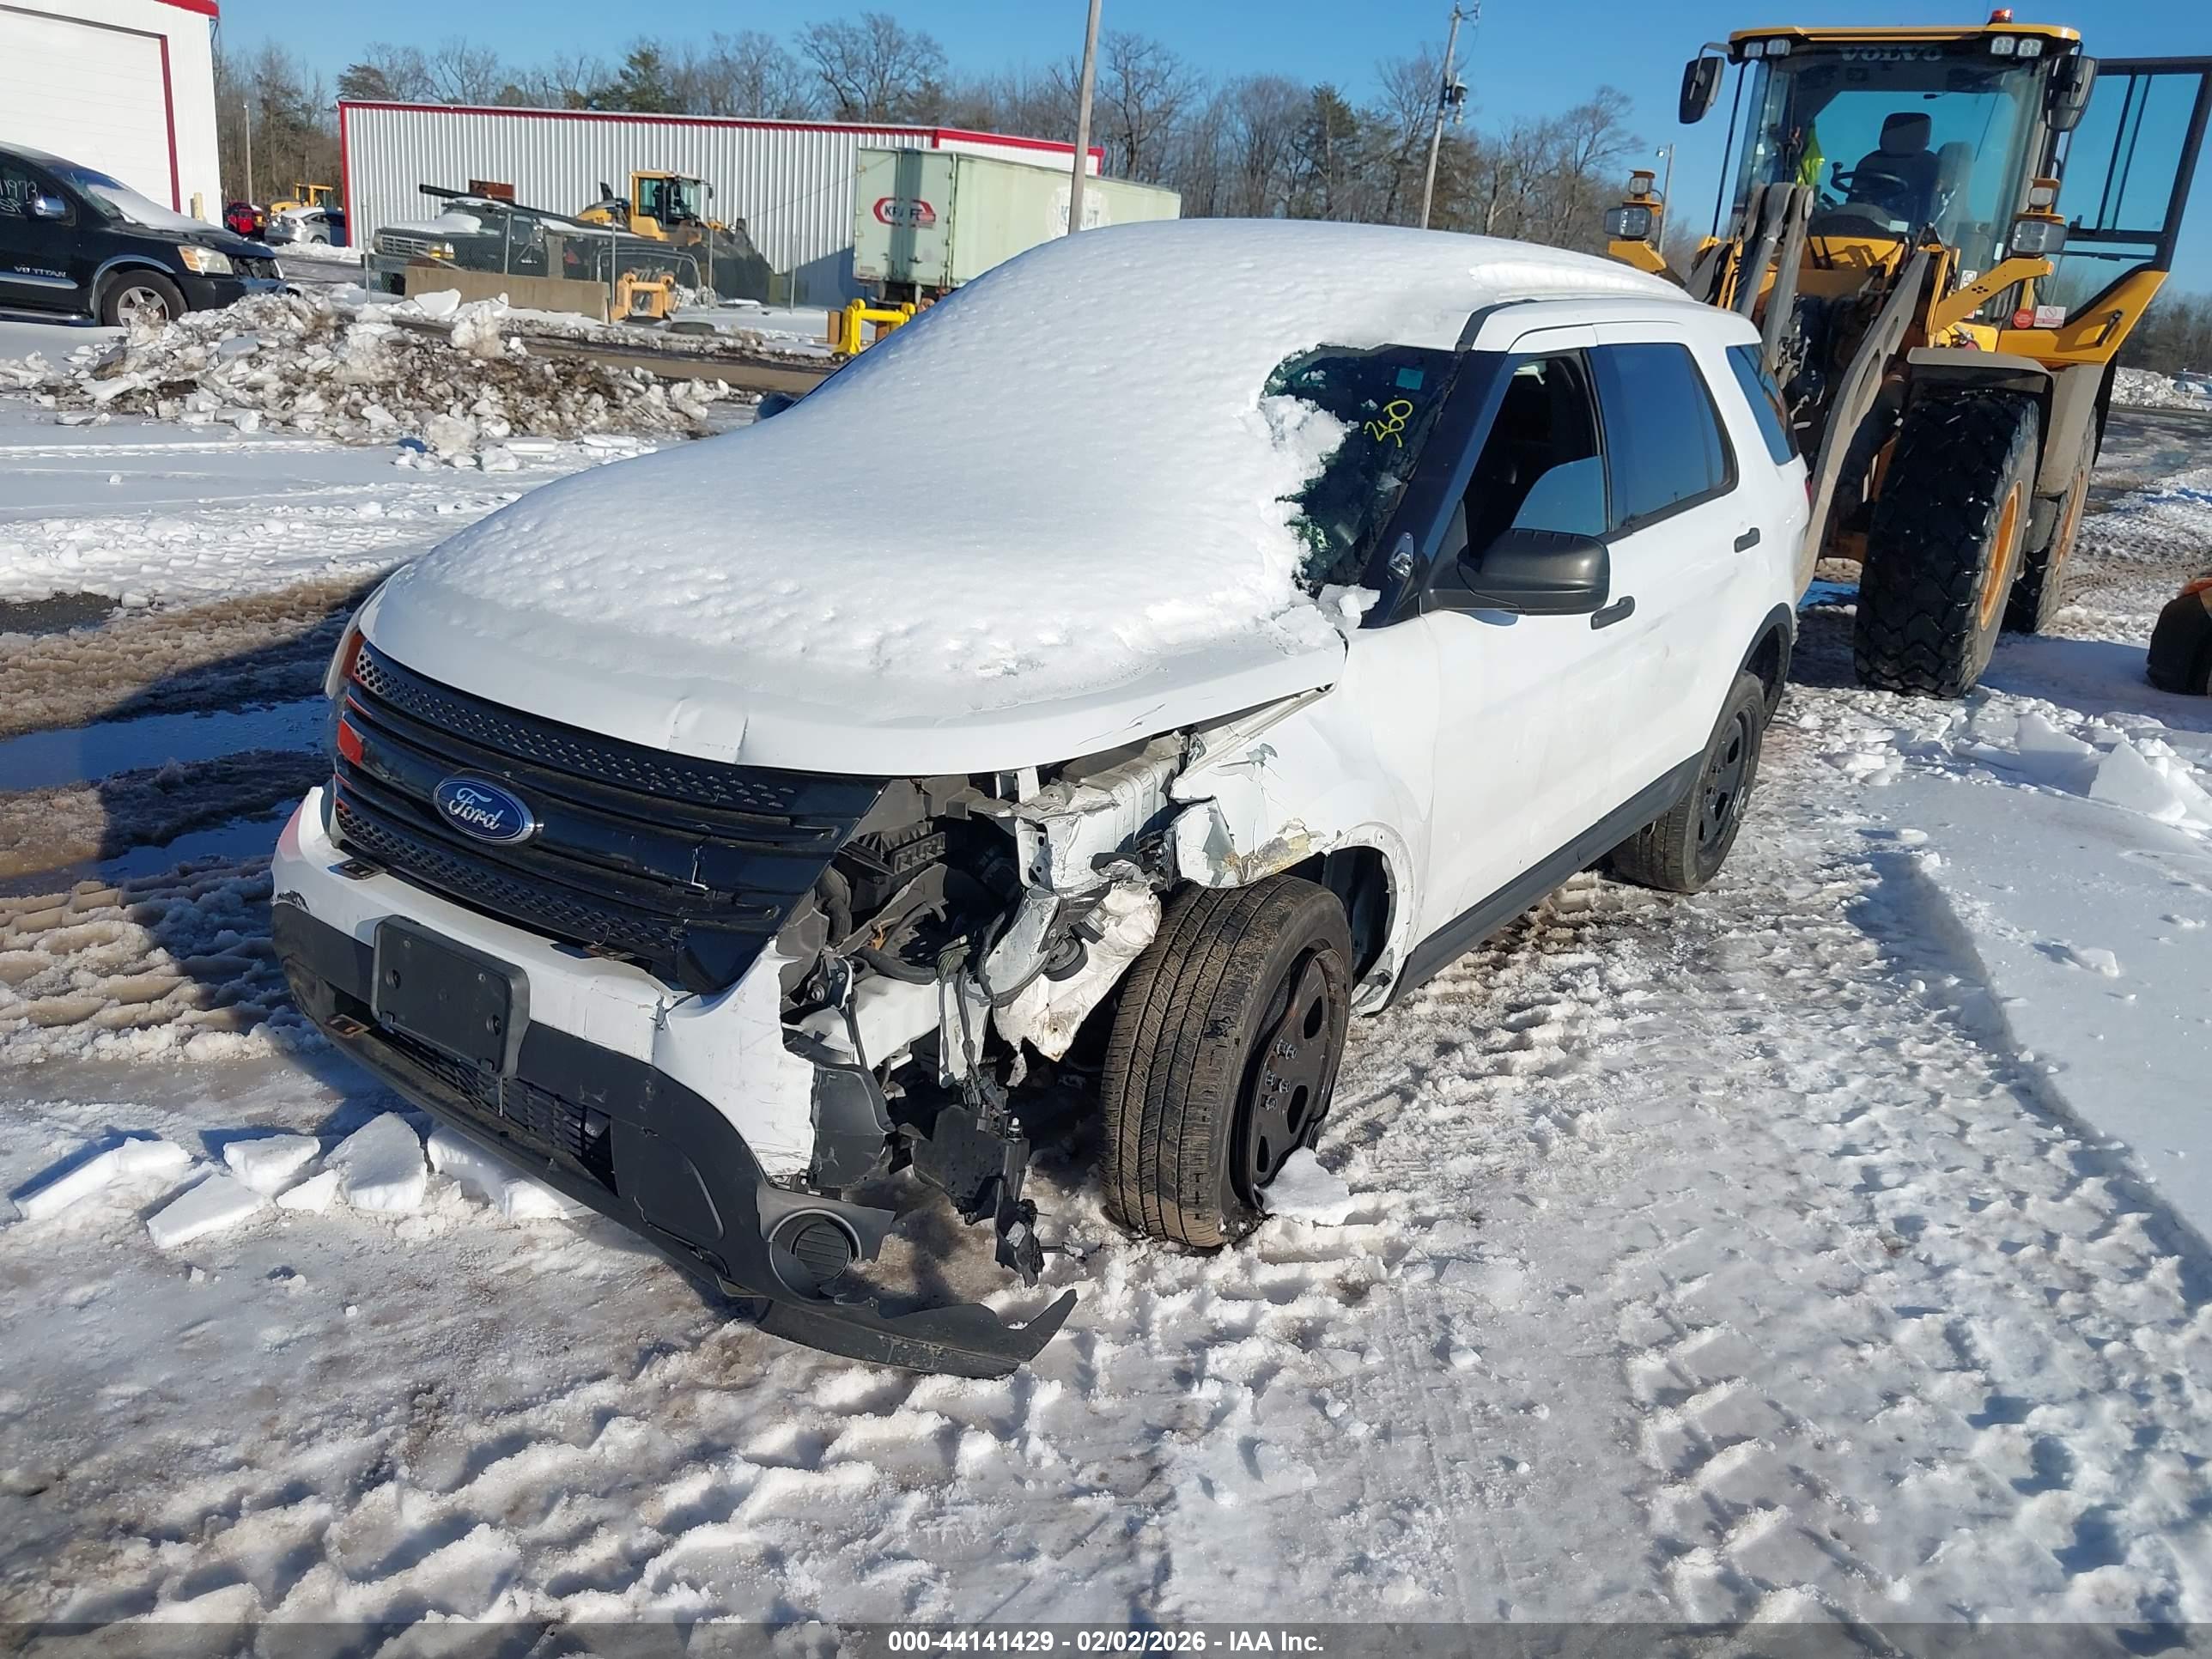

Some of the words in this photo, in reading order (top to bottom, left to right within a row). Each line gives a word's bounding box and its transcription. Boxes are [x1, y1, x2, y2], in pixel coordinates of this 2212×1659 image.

[1840, 46, 1943, 62] VOLVO
[32, 267, 66, 278] TITAN
[448, 787, 505, 830] Ford
